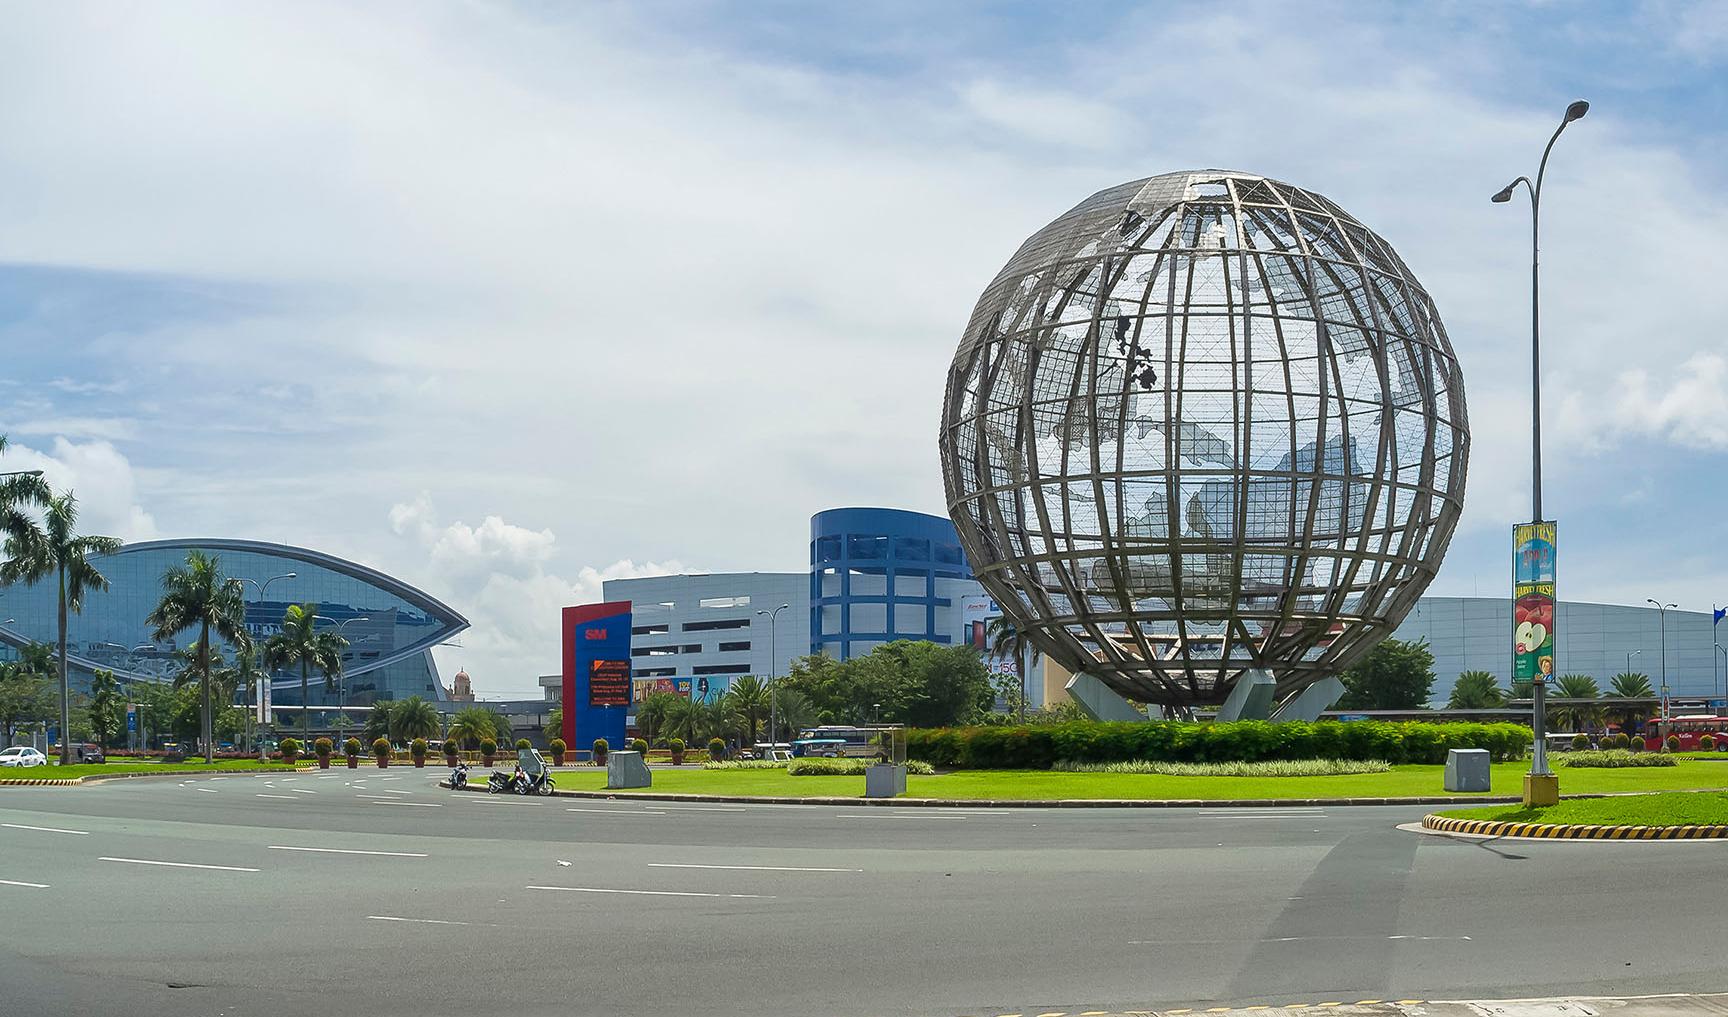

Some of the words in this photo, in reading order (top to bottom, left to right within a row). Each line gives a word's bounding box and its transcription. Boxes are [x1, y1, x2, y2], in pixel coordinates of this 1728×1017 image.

[1516, 585, 1534, 598] HARVEY
[1535, 584, 1553, 597] FRESH
[585, 629, 607, 640] SM
